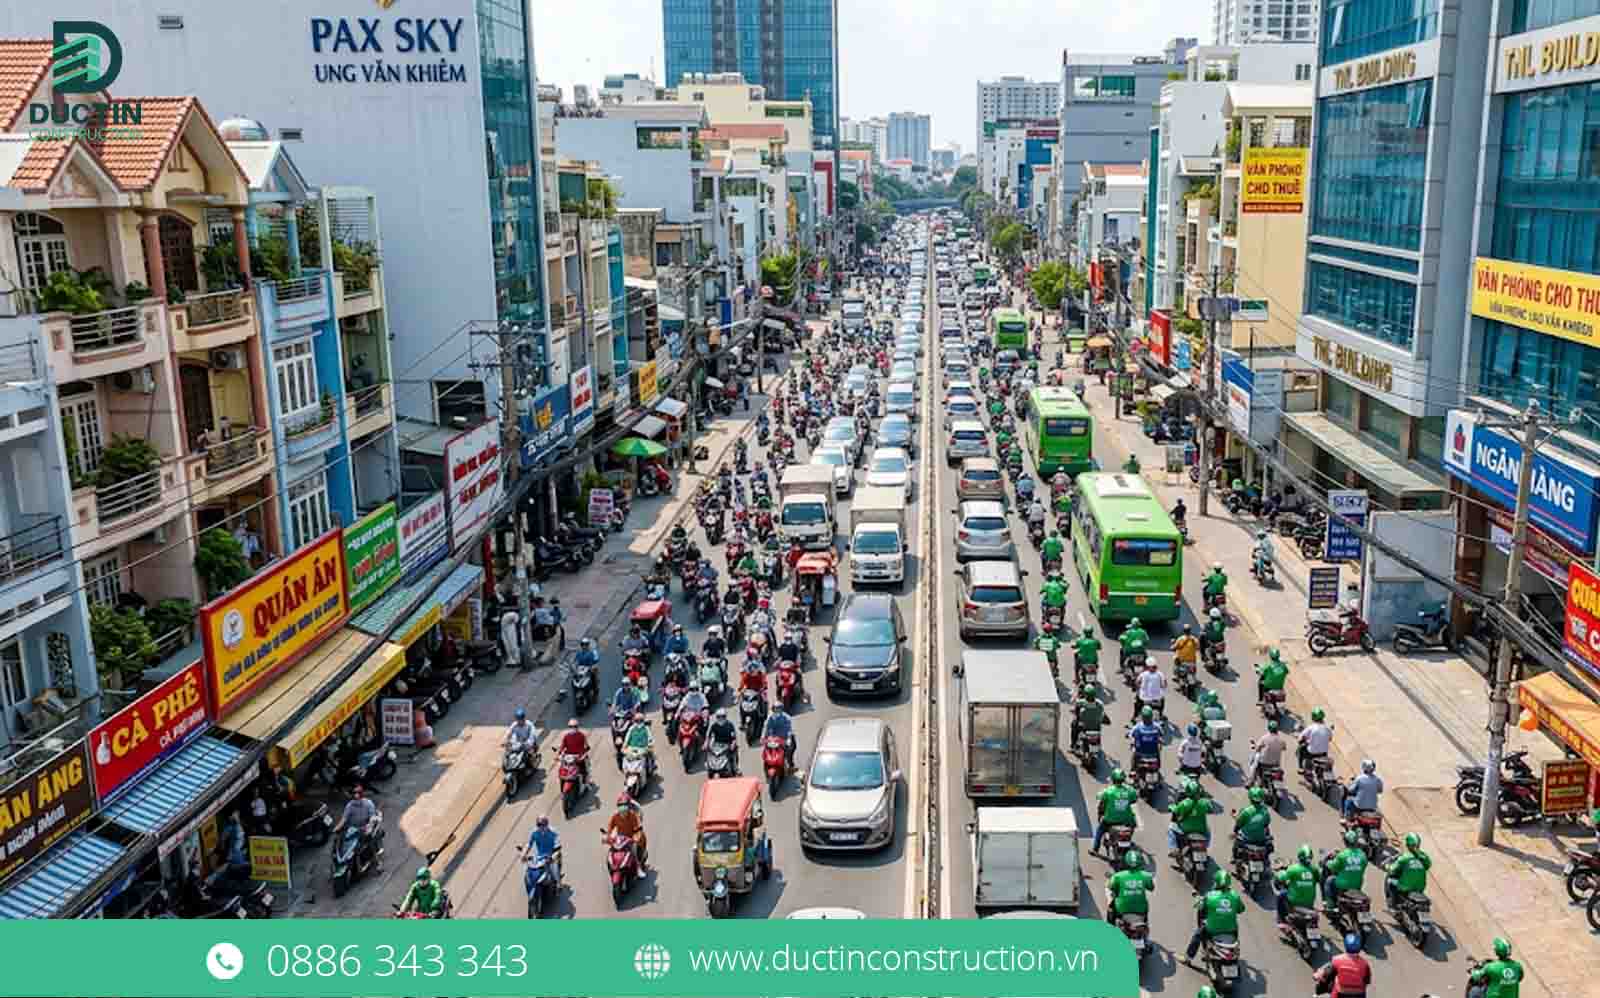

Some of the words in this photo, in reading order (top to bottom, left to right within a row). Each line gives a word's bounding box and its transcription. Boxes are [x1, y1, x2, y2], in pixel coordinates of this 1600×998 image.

[311, 18, 384, 53] PAX
[395, 18, 464, 53] SKY
[314, 63, 356, 83] UNG
[361, 58, 401, 83] VĂN
[1357, 50, 1416, 87] BUILDING
[1247, 182, 1269, 194] CHO
[1545, 281, 1573, 309] CHO
[1475, 441, 1521, 486] NGÂN
[254, 575, 309, 639] QUÁN
[152, 671, 200, 730] PHÊ
